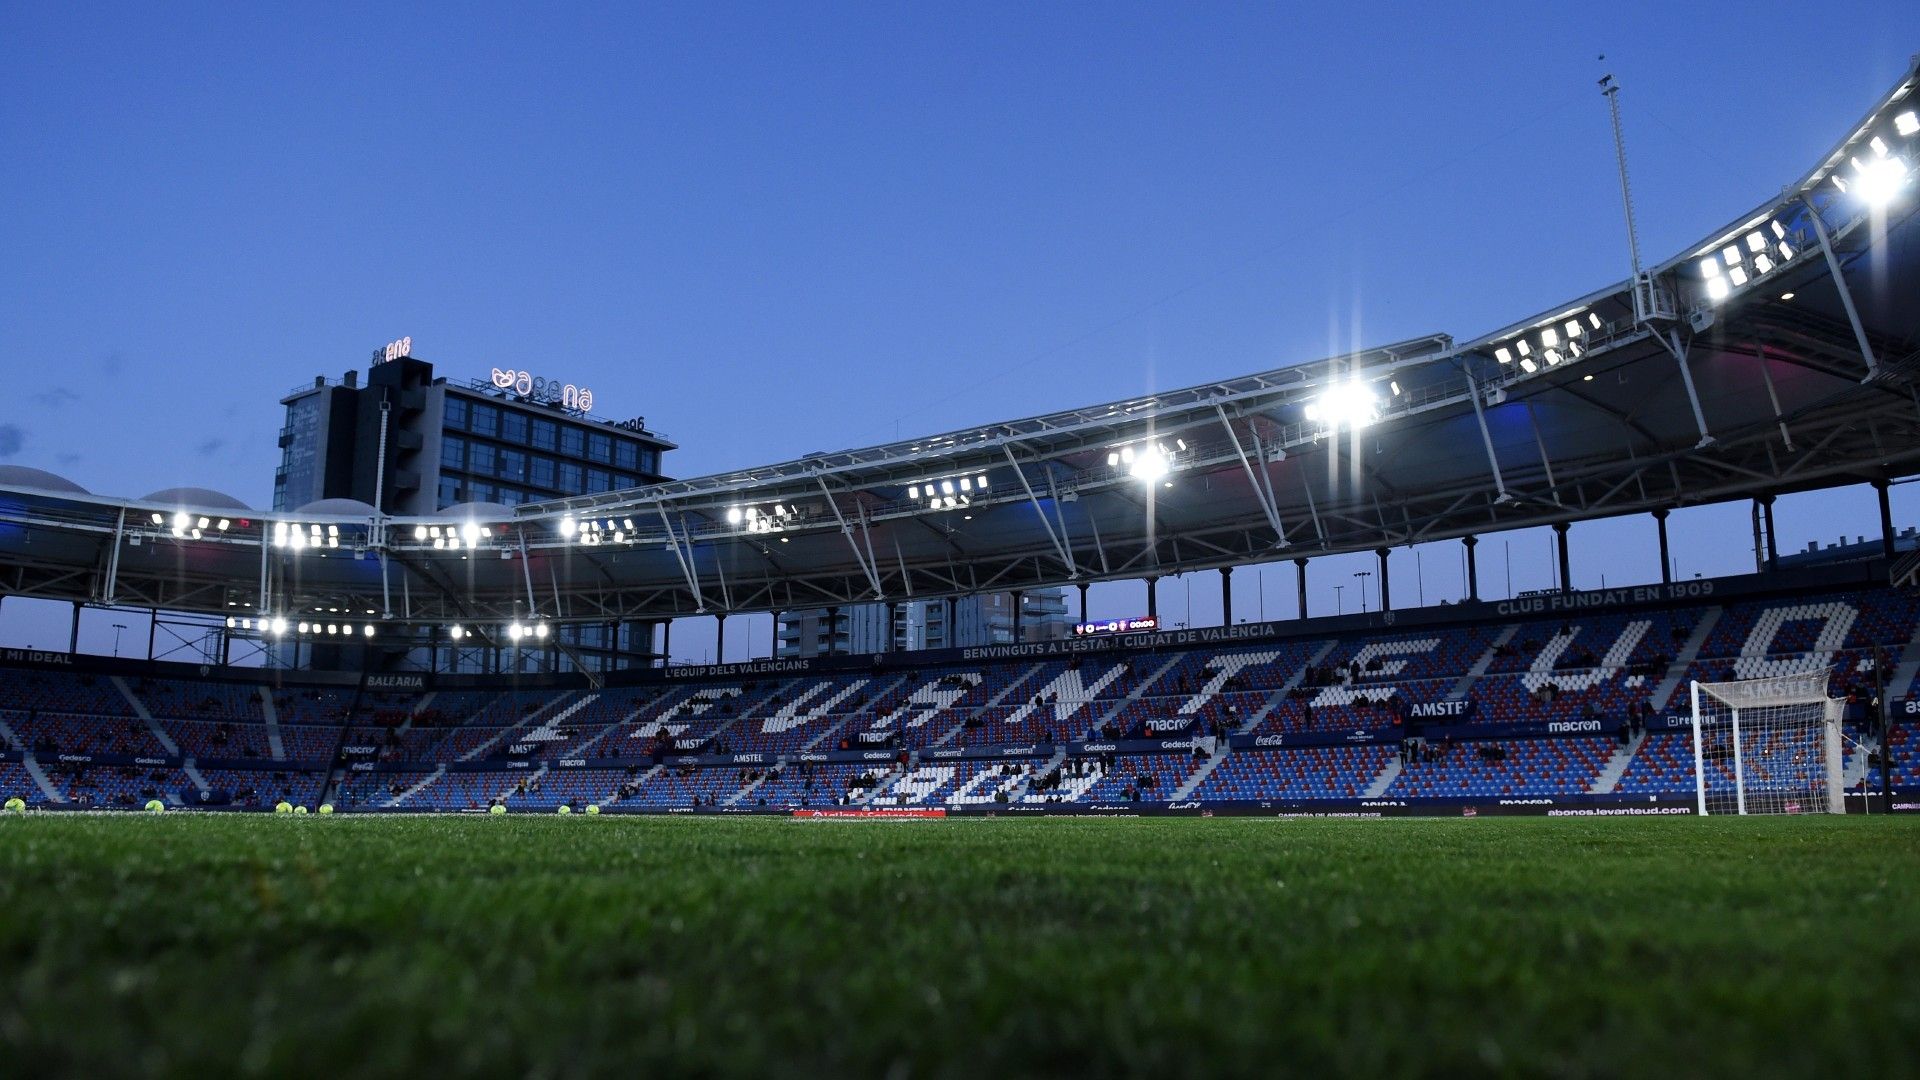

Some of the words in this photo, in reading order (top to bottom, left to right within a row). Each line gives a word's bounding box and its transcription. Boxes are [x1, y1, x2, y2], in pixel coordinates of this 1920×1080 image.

[1497, 598, 1544, 615] CLUB
[1551, 590, 1628, 609] FUNDAT
[1634, 587, 1660, 602] EN
[1667, 581, 1714, 599] 1909
[963, 643, 1044, 659] BENVINGUTS
[1048, 642, 1057, 653] A
[1124, 632, 1177, 648] CIUTAT
[1177, 631, 1196, 643] DE
[29, 652, 72, 664] IDEAL
[664, 668, 706, 678] L'EQUIP
[709, 665, 736, 676] DELS
[739, 660, 810, 674] VALENCIANS
[1548, 720, 1601, 732] macron
[933, 749, 962, 757] sesderma
[1003, 747, 1033, 755] sesderma
[733, 754, 763, 762] AMSTEL
[801, 753, 827, 761] Gedesco
[863, 752, 891, 760] Gedesco
[134, 757, 166, 765] Gedesco
[559, 759, 585, 767] macron
[1548, 806, 1690, 816] abonos.levanteud.com
